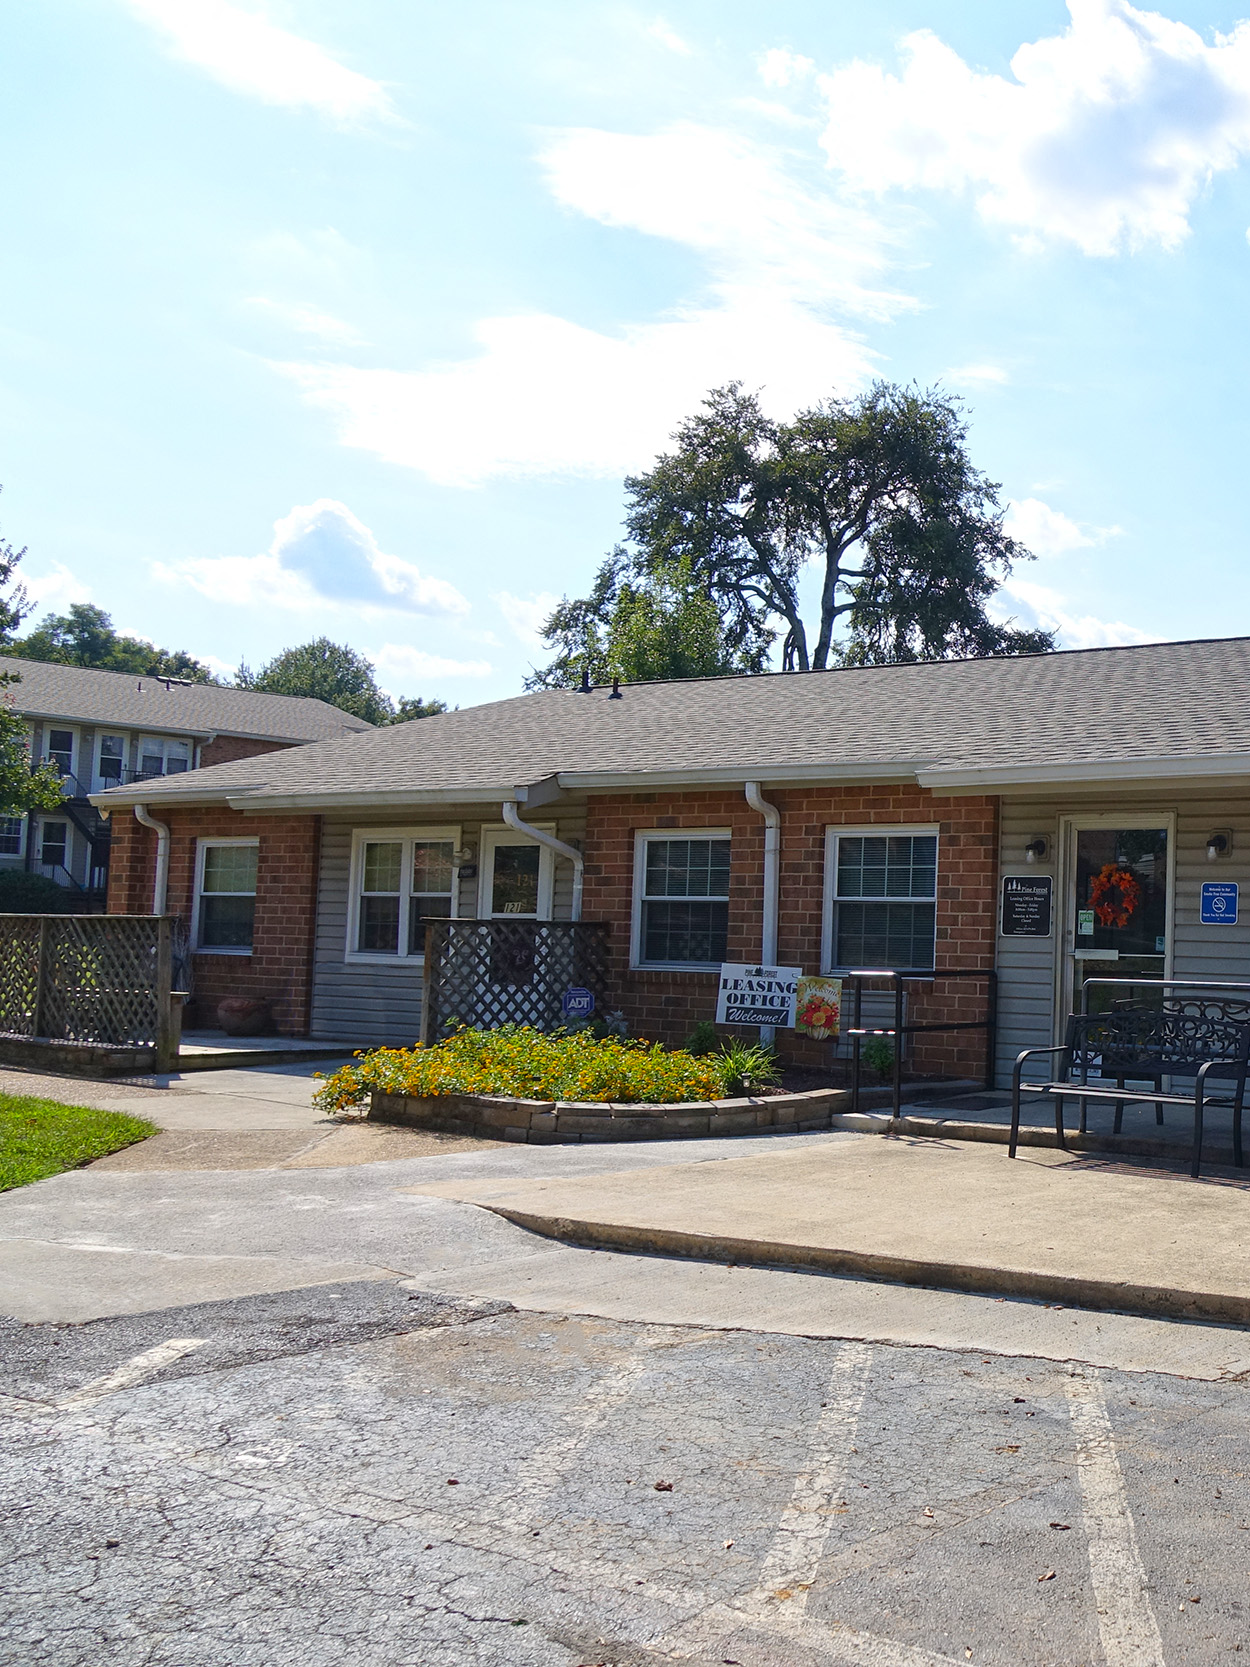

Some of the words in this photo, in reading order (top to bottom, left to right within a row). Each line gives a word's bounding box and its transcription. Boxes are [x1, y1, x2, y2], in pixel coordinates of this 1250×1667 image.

[505, 903, 520, 913] 121
[722, 979, 798, 994] LEASING
[568, 997, 590, 1009] ADT
[726, 993, 790, 1008] OFFICE
[728, 1008, 786, 1023] Welcome!
